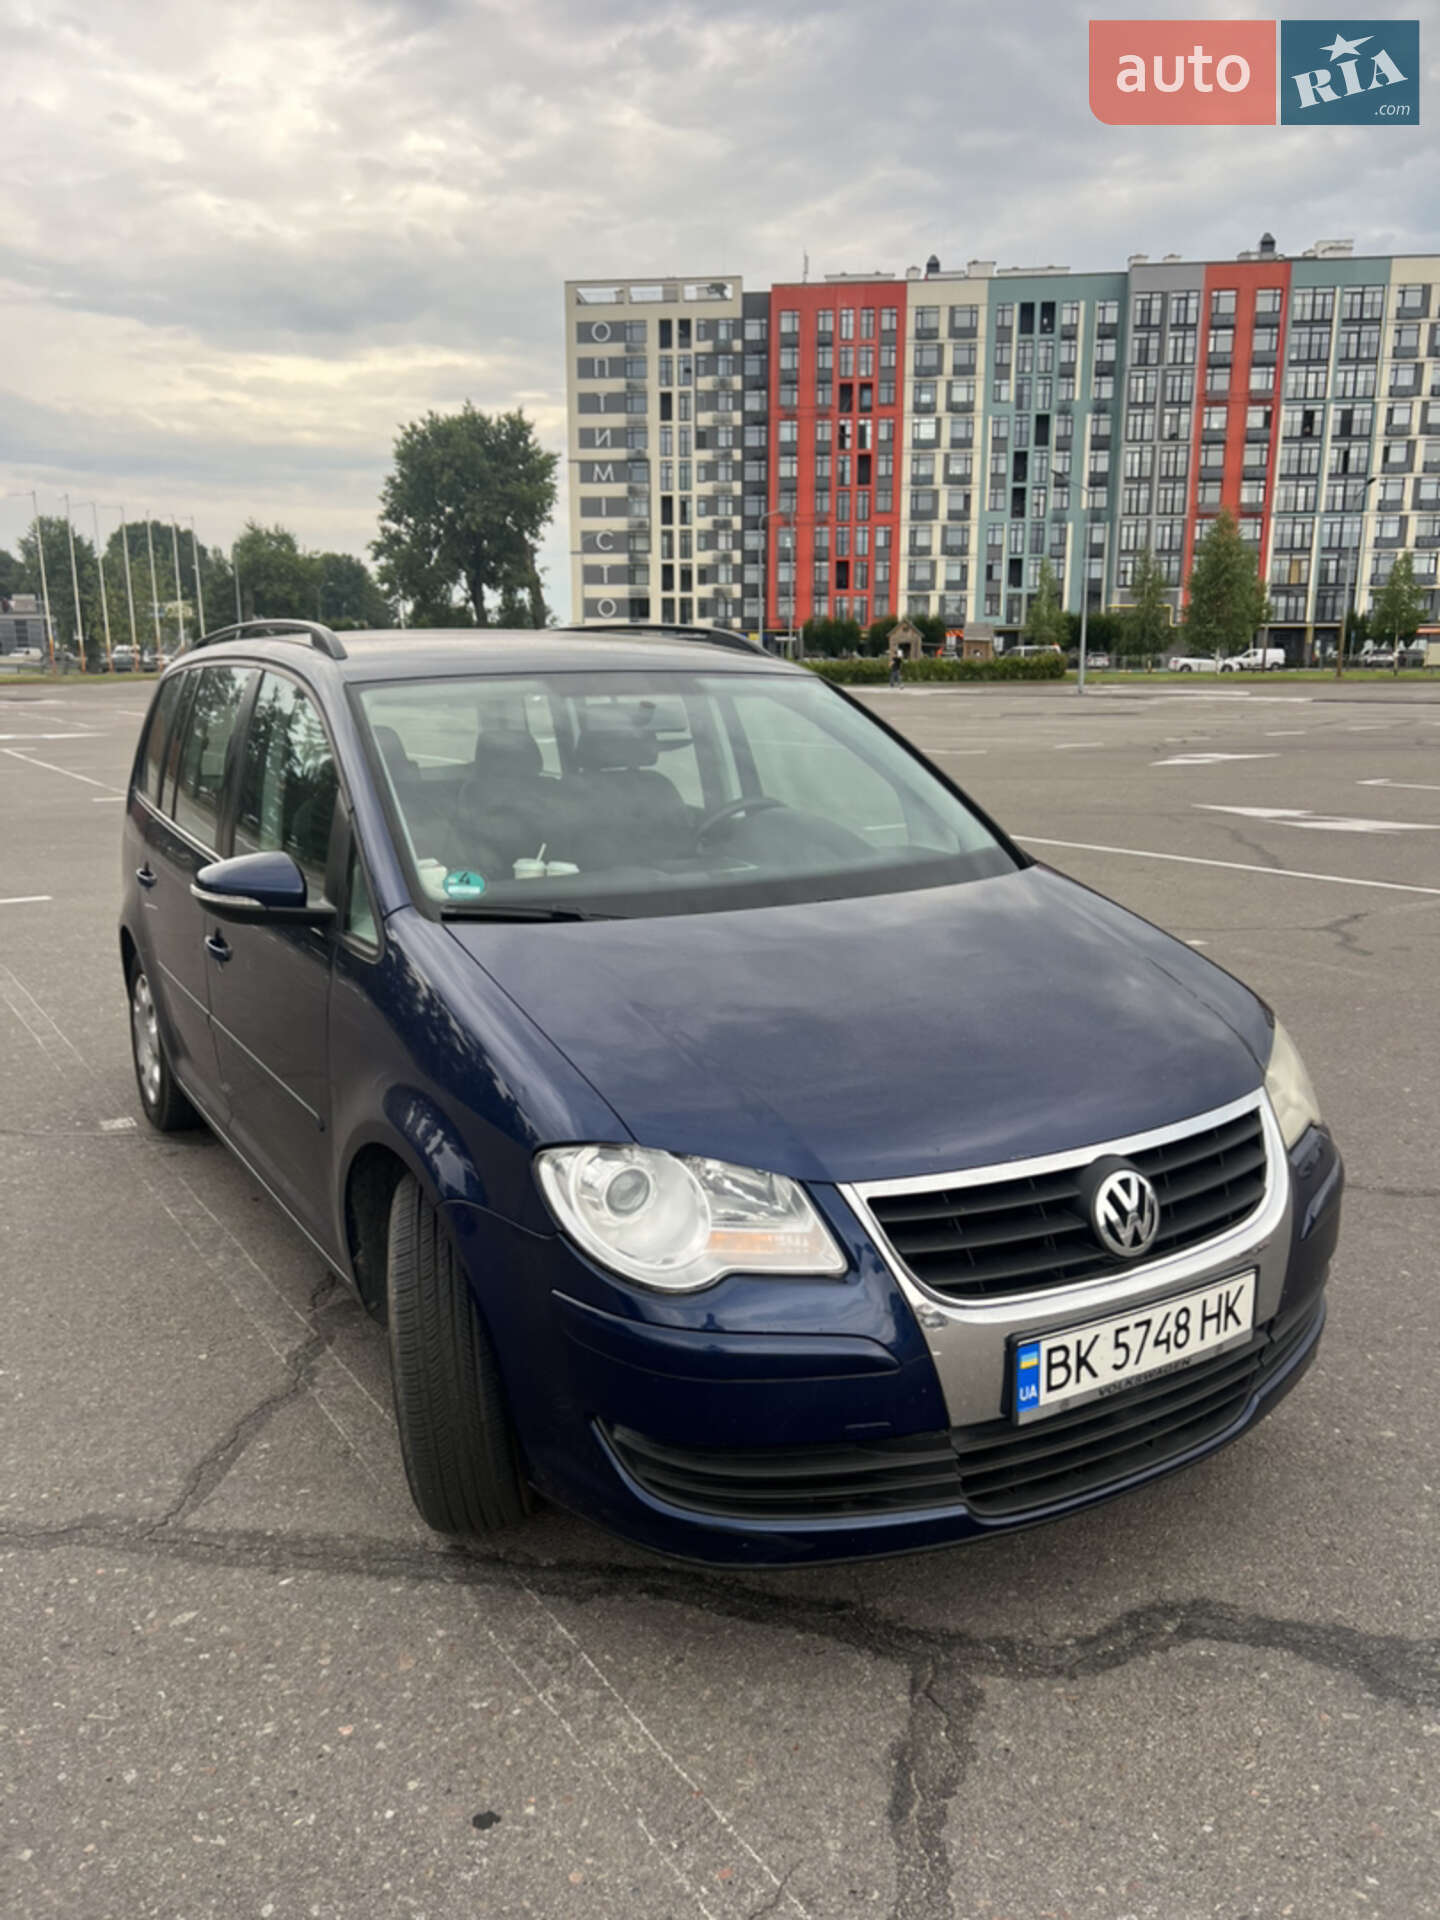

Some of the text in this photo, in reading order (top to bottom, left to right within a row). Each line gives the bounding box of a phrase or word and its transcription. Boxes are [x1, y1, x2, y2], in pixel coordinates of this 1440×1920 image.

[1045, 1284, 1245, 1393] BK 5748 HK
[1019, 1384, 1038, 1401] UA
